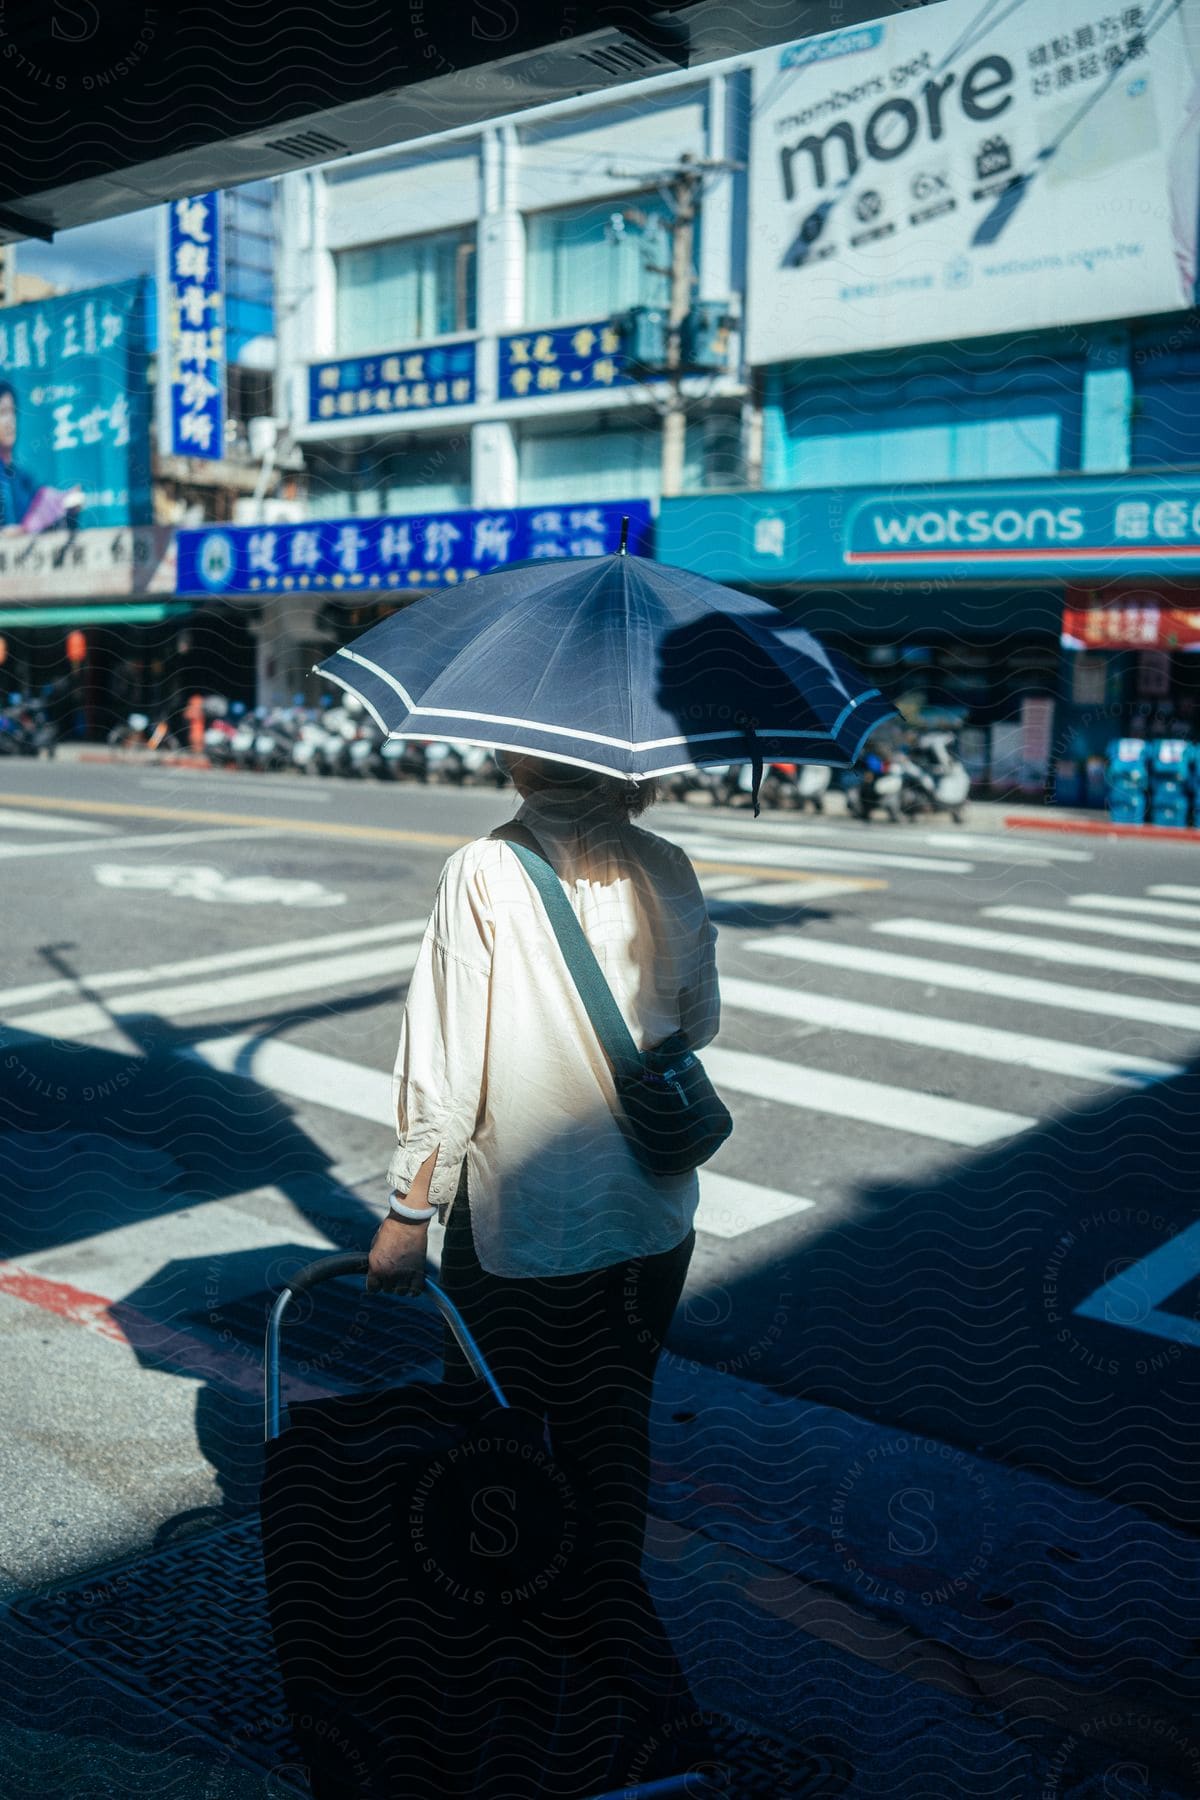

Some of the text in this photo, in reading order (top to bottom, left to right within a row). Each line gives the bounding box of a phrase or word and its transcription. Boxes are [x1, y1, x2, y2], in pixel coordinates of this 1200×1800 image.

[889, 51, 931, 90] get
[780, 55, 1014, 201] more
[873, 506, 1084, 544] watsons
